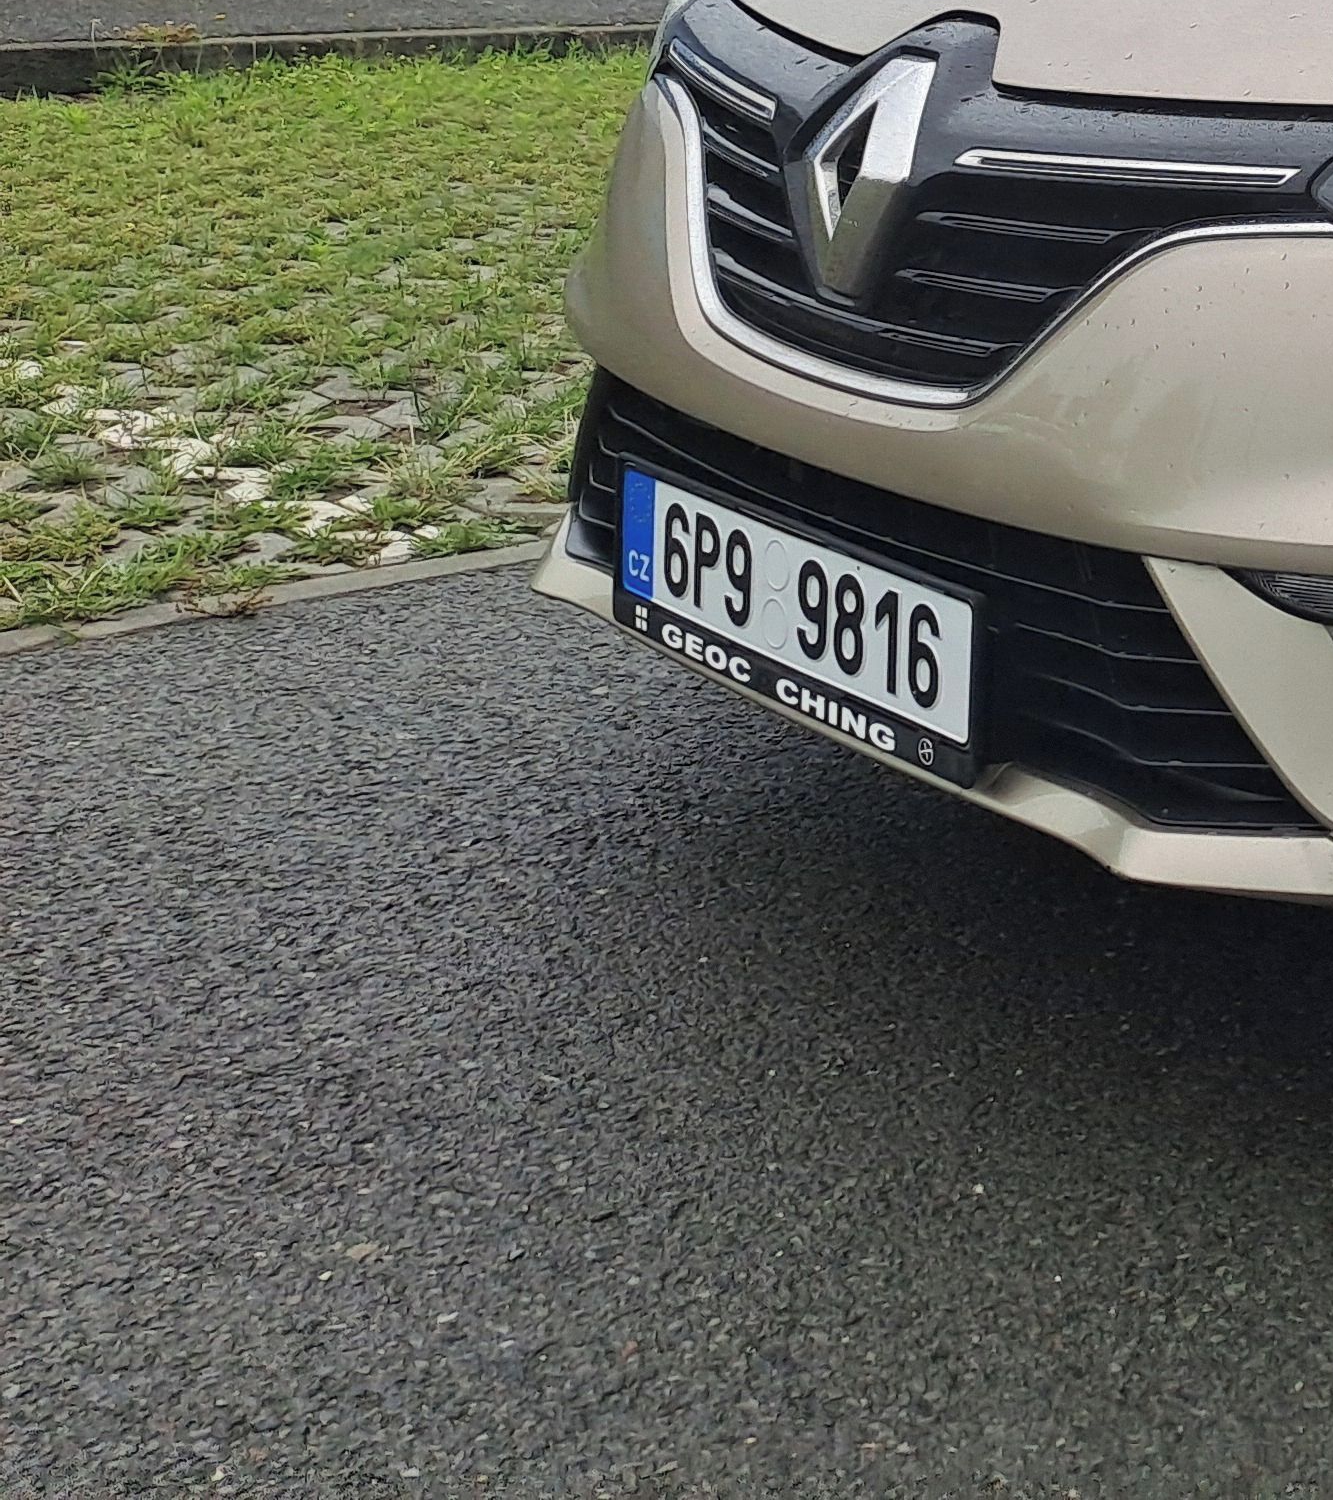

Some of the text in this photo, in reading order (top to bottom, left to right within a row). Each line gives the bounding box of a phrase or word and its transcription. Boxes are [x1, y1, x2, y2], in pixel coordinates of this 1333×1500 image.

[628, 550, 651, 582] CZ
[663, 502, 942, 709] 6P9 9816
